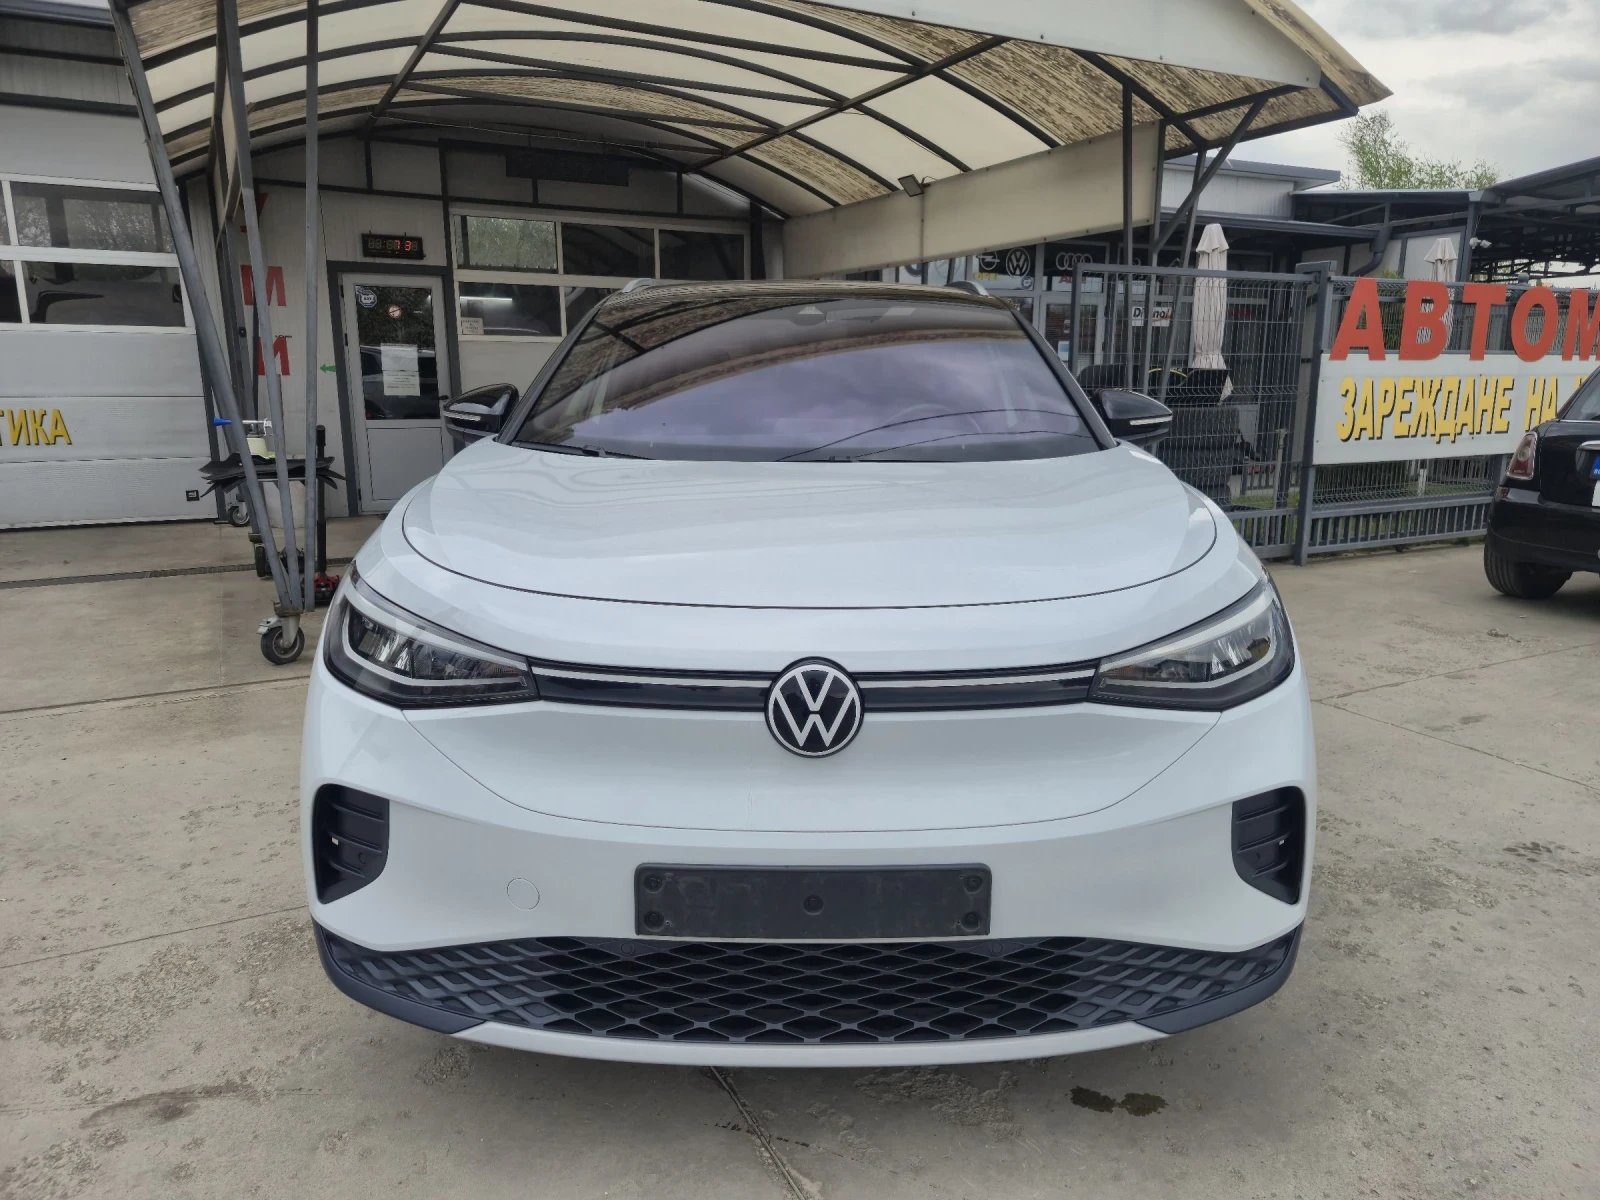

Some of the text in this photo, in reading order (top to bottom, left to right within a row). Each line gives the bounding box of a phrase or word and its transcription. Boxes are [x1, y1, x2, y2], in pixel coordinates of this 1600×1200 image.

[1336, 375, 1559, 444] ЗАРЕЖДАНЕ НА
[770, 666, 859, 753] VW
